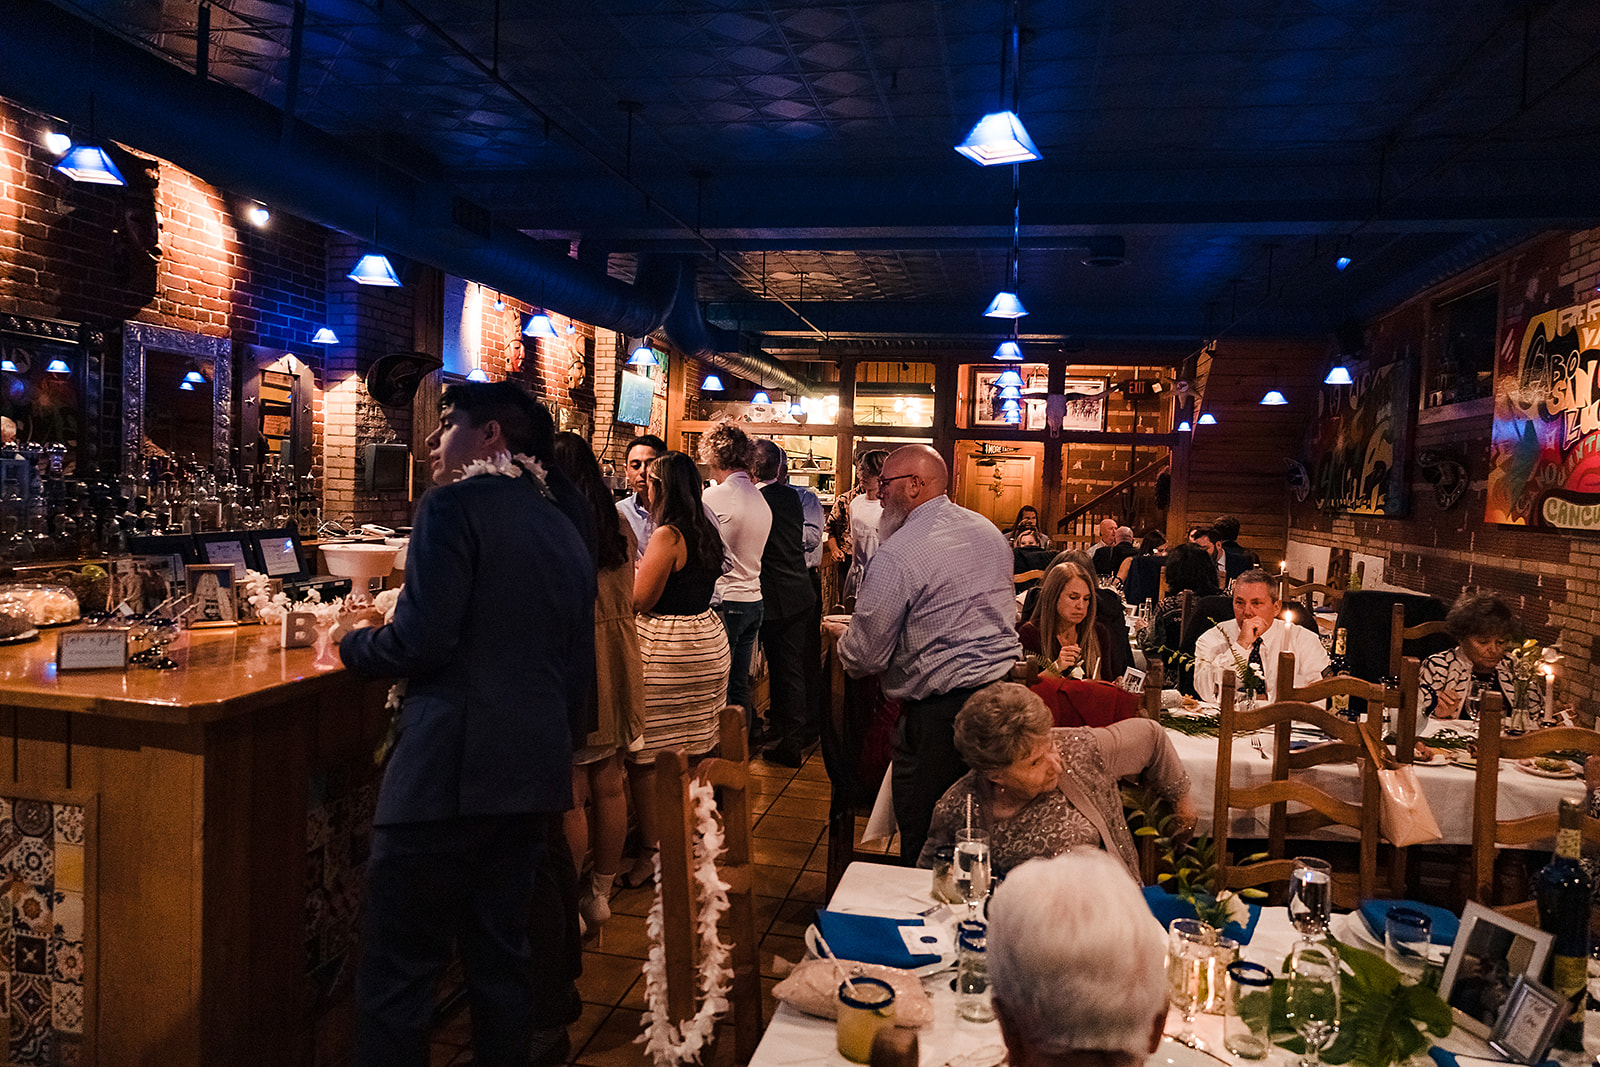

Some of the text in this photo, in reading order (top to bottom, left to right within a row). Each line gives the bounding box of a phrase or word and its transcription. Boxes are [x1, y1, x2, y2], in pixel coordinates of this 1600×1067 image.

[1129, 381, 1145, 394] EXIT
[1546, 360, 1598, 416] SAN
[281, 611, 319, 648] B
